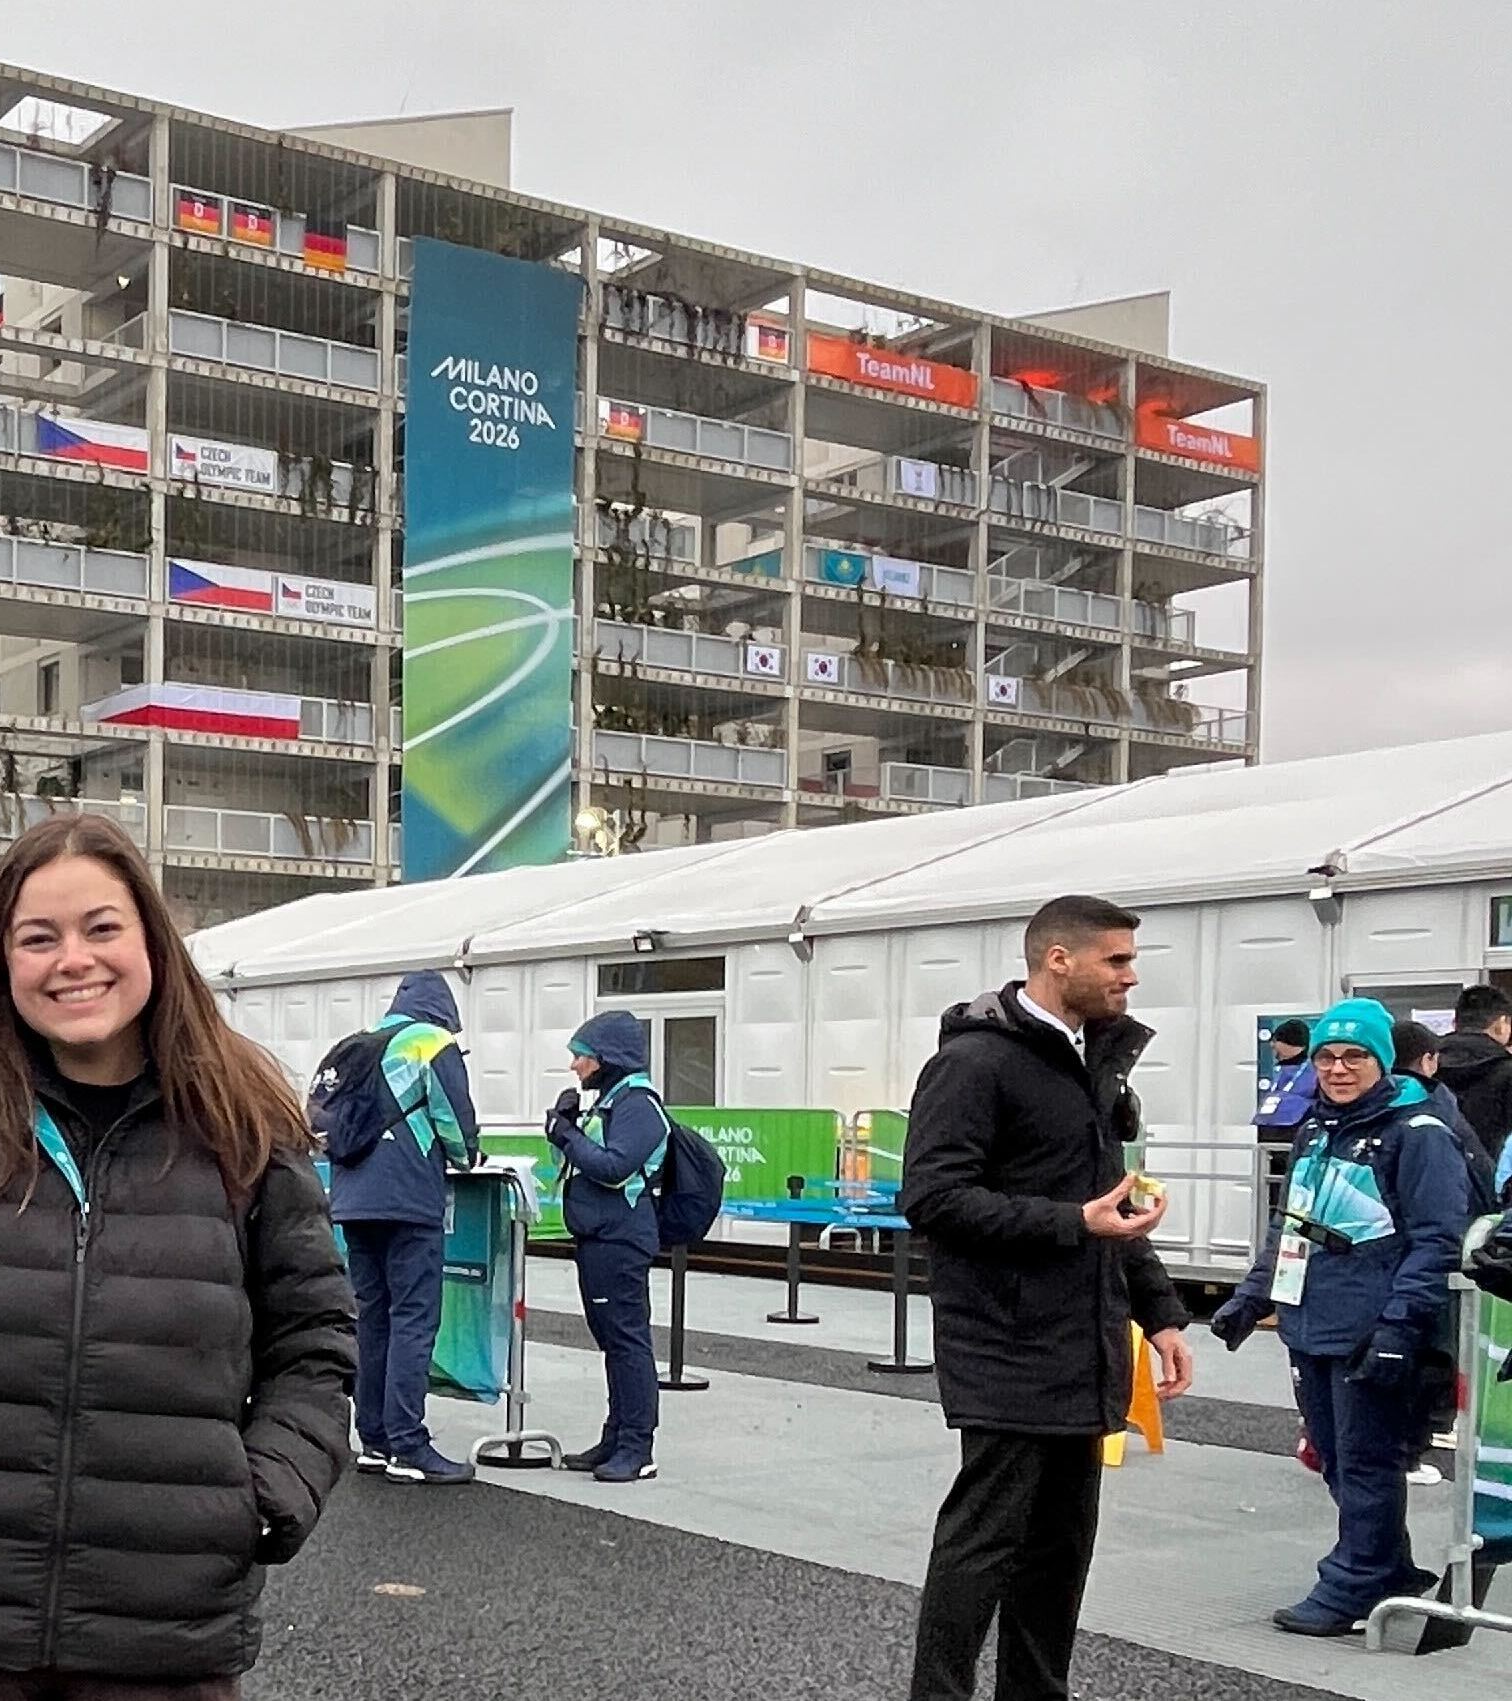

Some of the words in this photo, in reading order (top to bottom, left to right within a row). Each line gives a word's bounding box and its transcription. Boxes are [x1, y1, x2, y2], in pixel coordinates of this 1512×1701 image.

[430, 356, 538, 396] MILANO
[855, 351, 936, 390] TeamNL
[449, 386, 556, 430] CORTINA
[469, 418, 520, 450] 2026
[1166, 424, 1234, 458] TeamNL
[716, 1146, 767, 1164] RTINA
